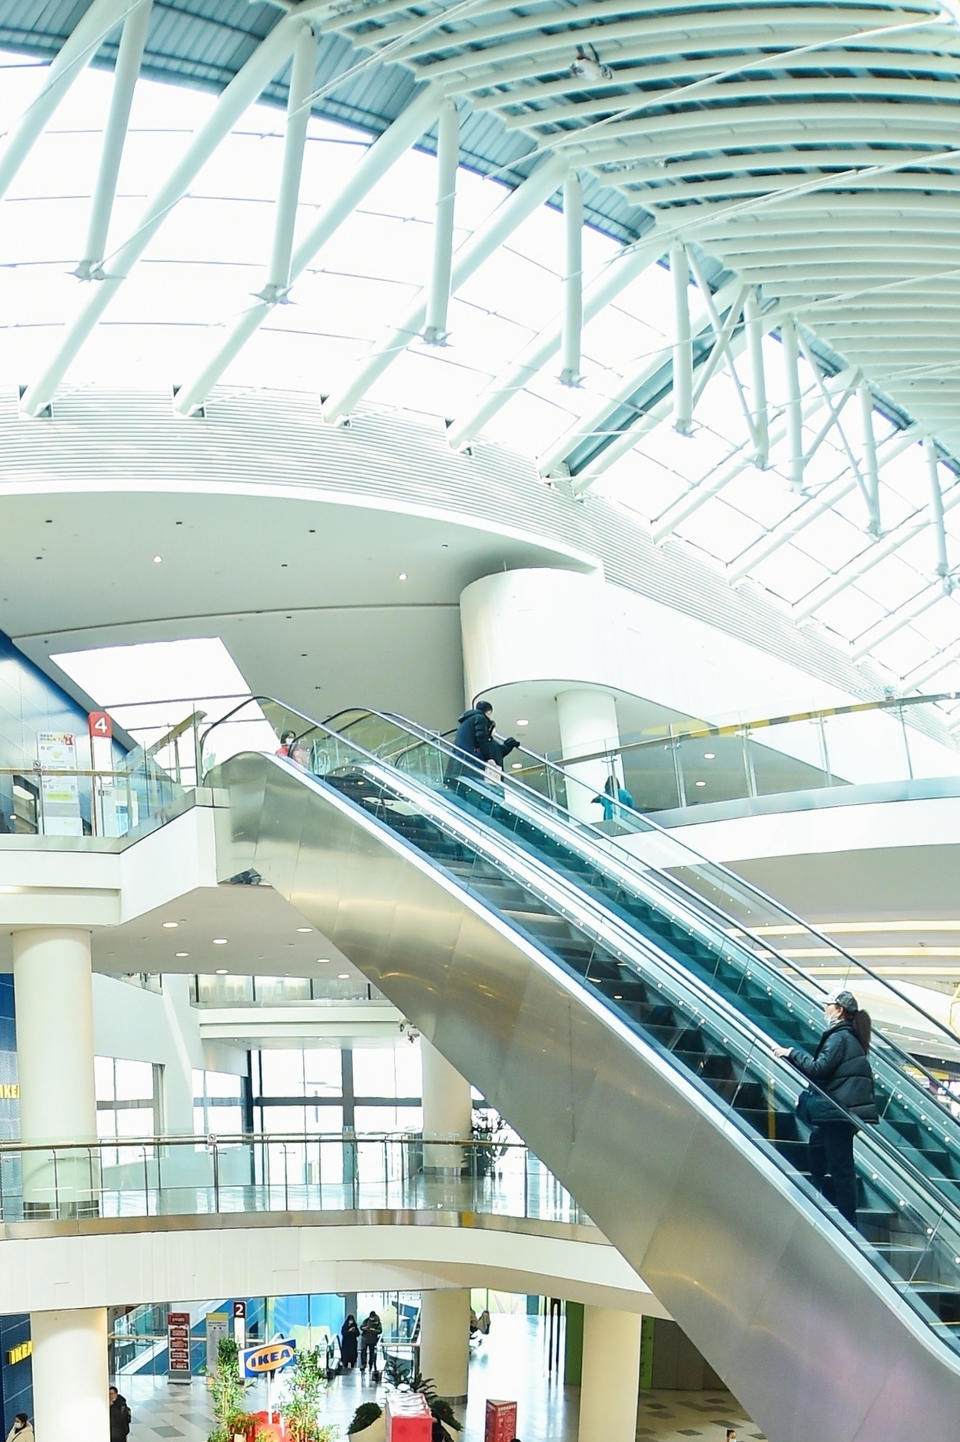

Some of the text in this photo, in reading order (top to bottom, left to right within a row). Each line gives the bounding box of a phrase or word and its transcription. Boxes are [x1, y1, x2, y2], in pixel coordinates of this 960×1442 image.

[95, 717, 107, 734] 4
[235, 1304, 244, 1316] 2
[250, 1349, 291, 1367] IKEA
